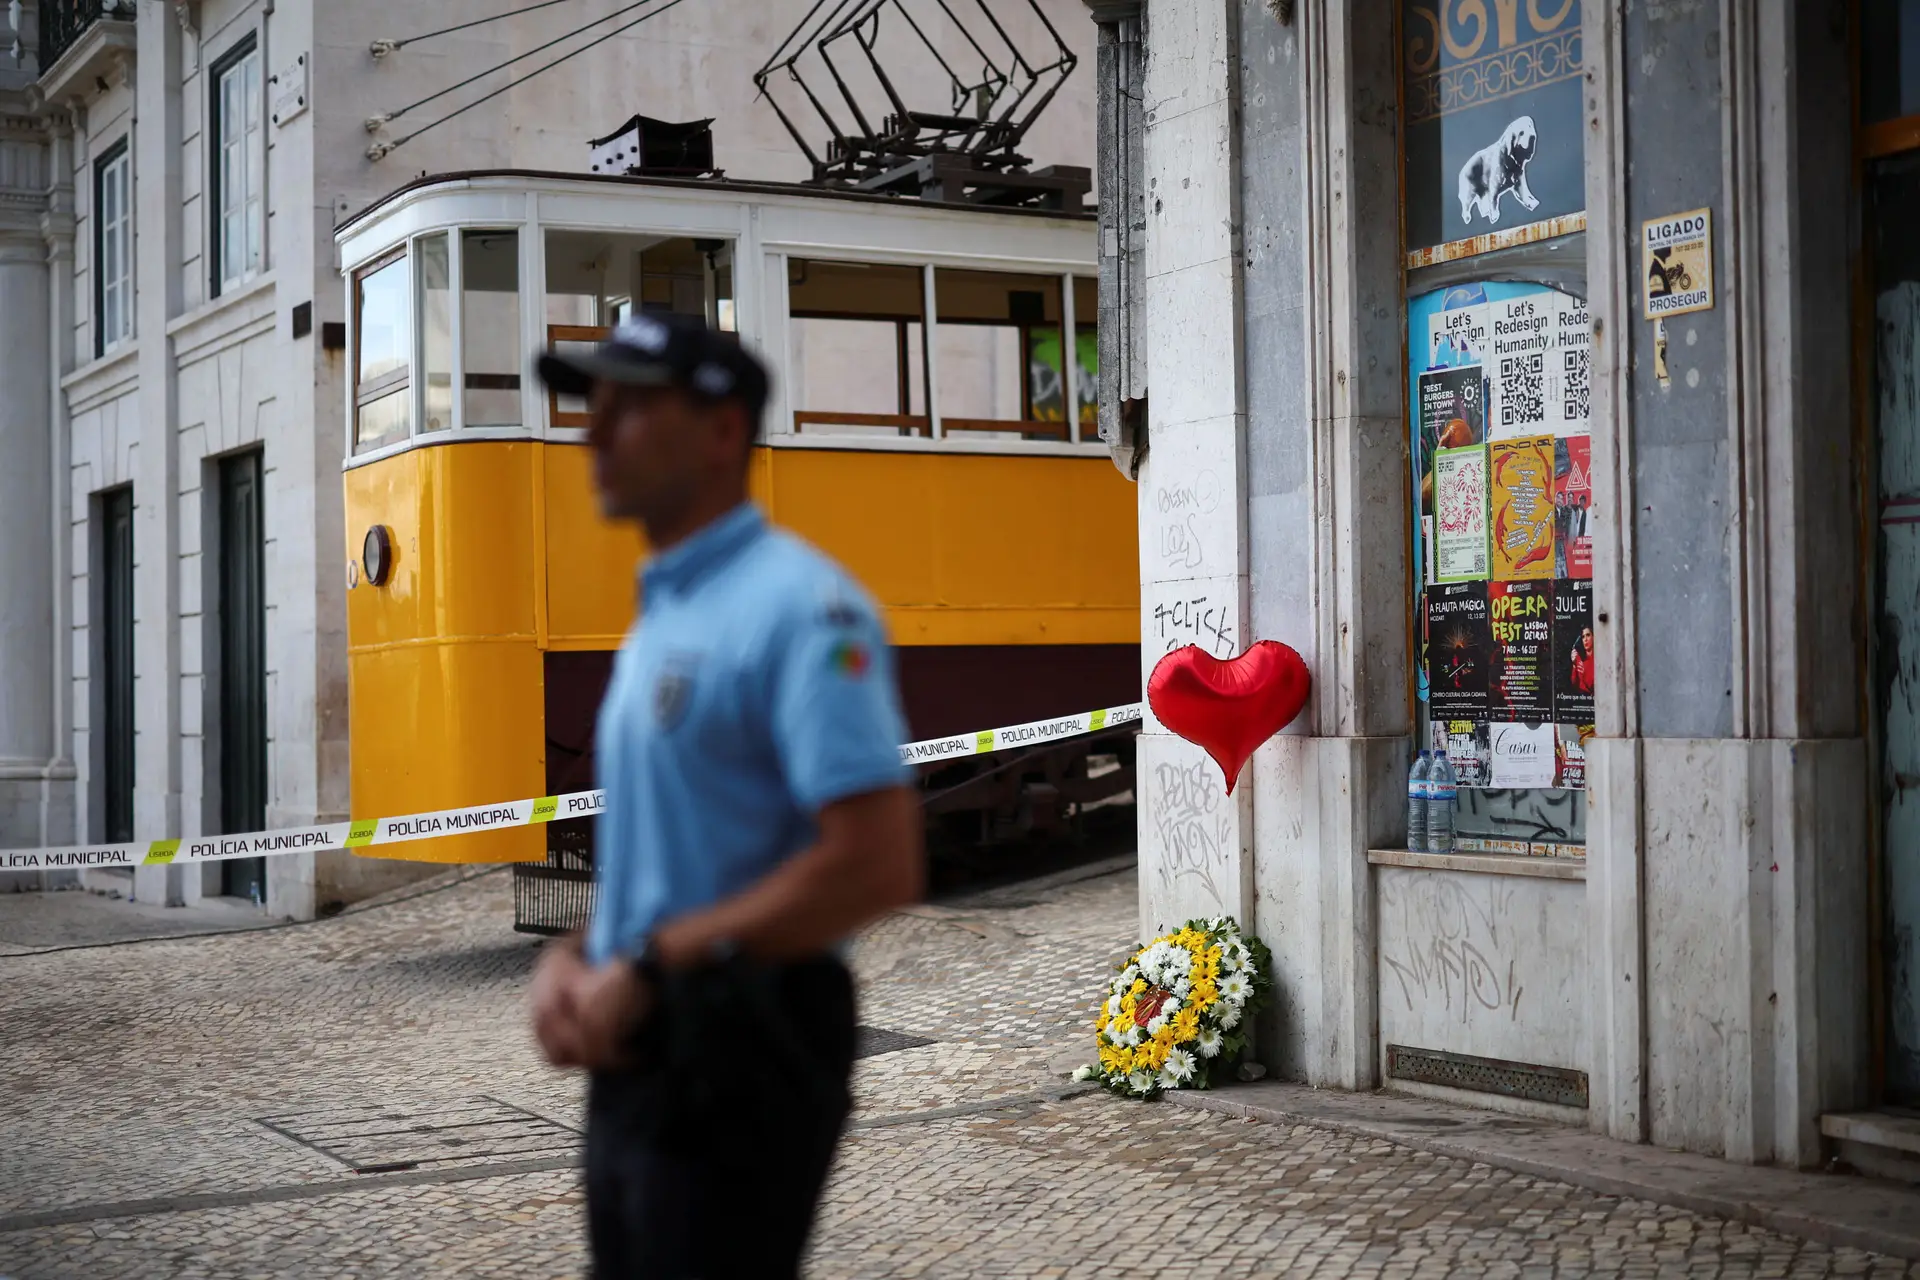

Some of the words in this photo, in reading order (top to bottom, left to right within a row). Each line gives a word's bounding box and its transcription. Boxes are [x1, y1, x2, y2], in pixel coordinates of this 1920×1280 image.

[1648, 216, 1704, 241] LIGADO
[1507, 301, 1534, 318] Let's
[1649, 291, 1707, 313] PROSEGUR
[1446, 312, 1471, 329] Let's
[1495, 315, 1548, 335] Redesign
[1495, 334, 1548, 354] Humanity
[1424, 390, 1454, 402] BURGERS
[1430, 604, 1435, 614] A
[1435, 601, 1458, 613] FLAUTA
[1459, 599, 1486, 611] MÁGICA
[1492, 594, 1548, 619] OPERA
[1556, 596, 1587, 612] JULIE
[1492, 621, 1522, 642] FEST
[1524, 621, 1548, 630] LISBOA
[1524, 631, 1548, 640] OEIRAS
[1111, 708, 1141, 724] POLÍCIA
[1001, 727, 1035, 744] POLÍCIA
[1038, 719, 1082, 738] MUNICIPAL
[915, 738, 969, 756] MUNICIPAL
[388, 817, 442, 837] POLÍCIA
[446, 808, 520, 829] MUNICIPAL
[190, 839, 249, 857] POLÍCIA
[254, 830, 334, 852] MUNICIPAL
[45, 850, 132, 866] MUNICIPAL
